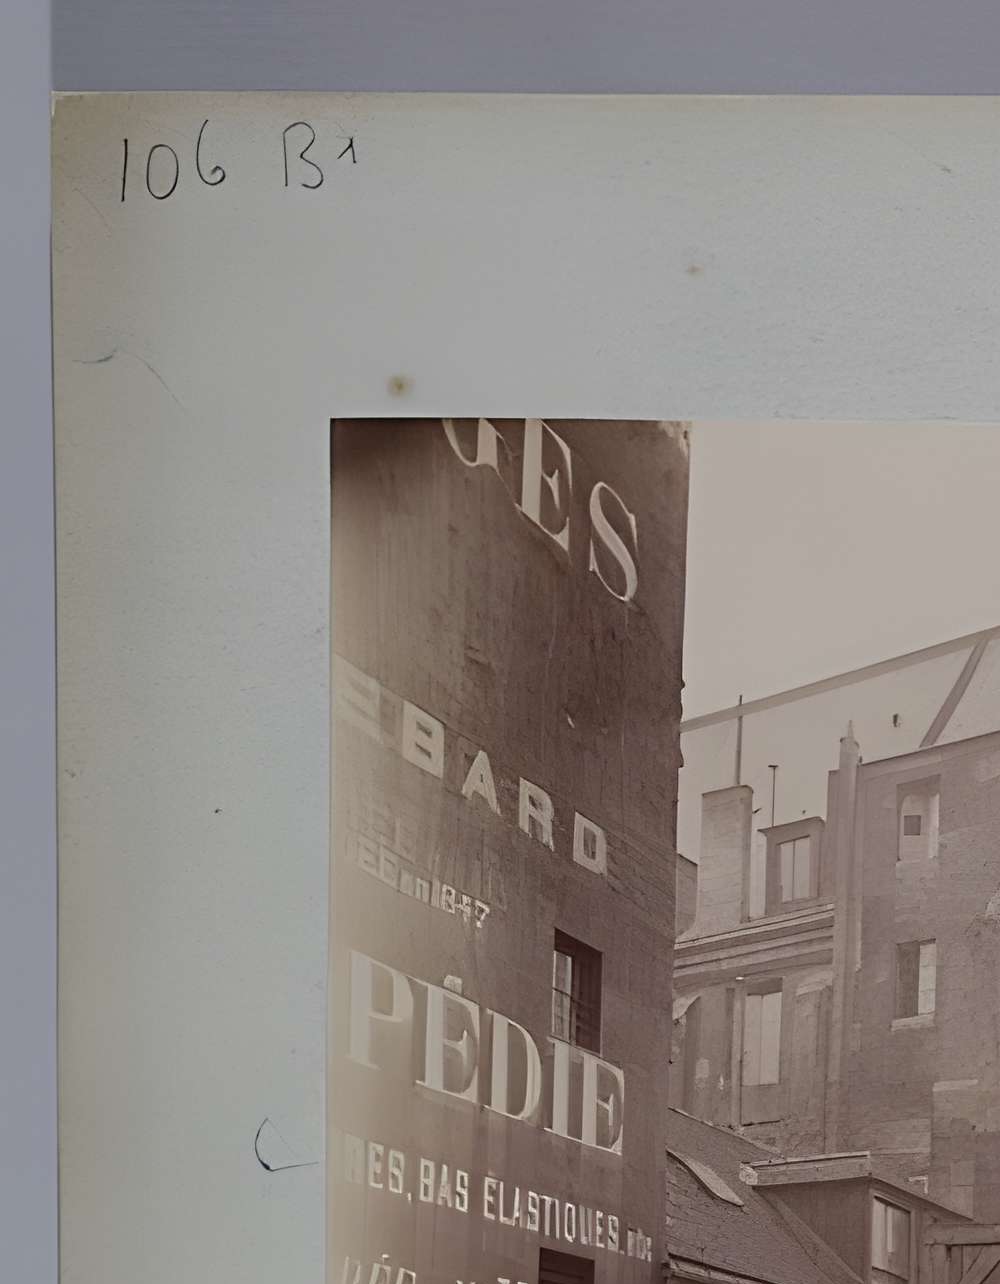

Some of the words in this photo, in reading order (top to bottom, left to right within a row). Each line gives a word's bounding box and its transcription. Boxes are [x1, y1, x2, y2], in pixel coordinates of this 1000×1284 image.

[121, 118, 227, 203] 106
[346, 949, 626, 1156] PÉDIE
[420, 1157, 469, 1214] BAS
